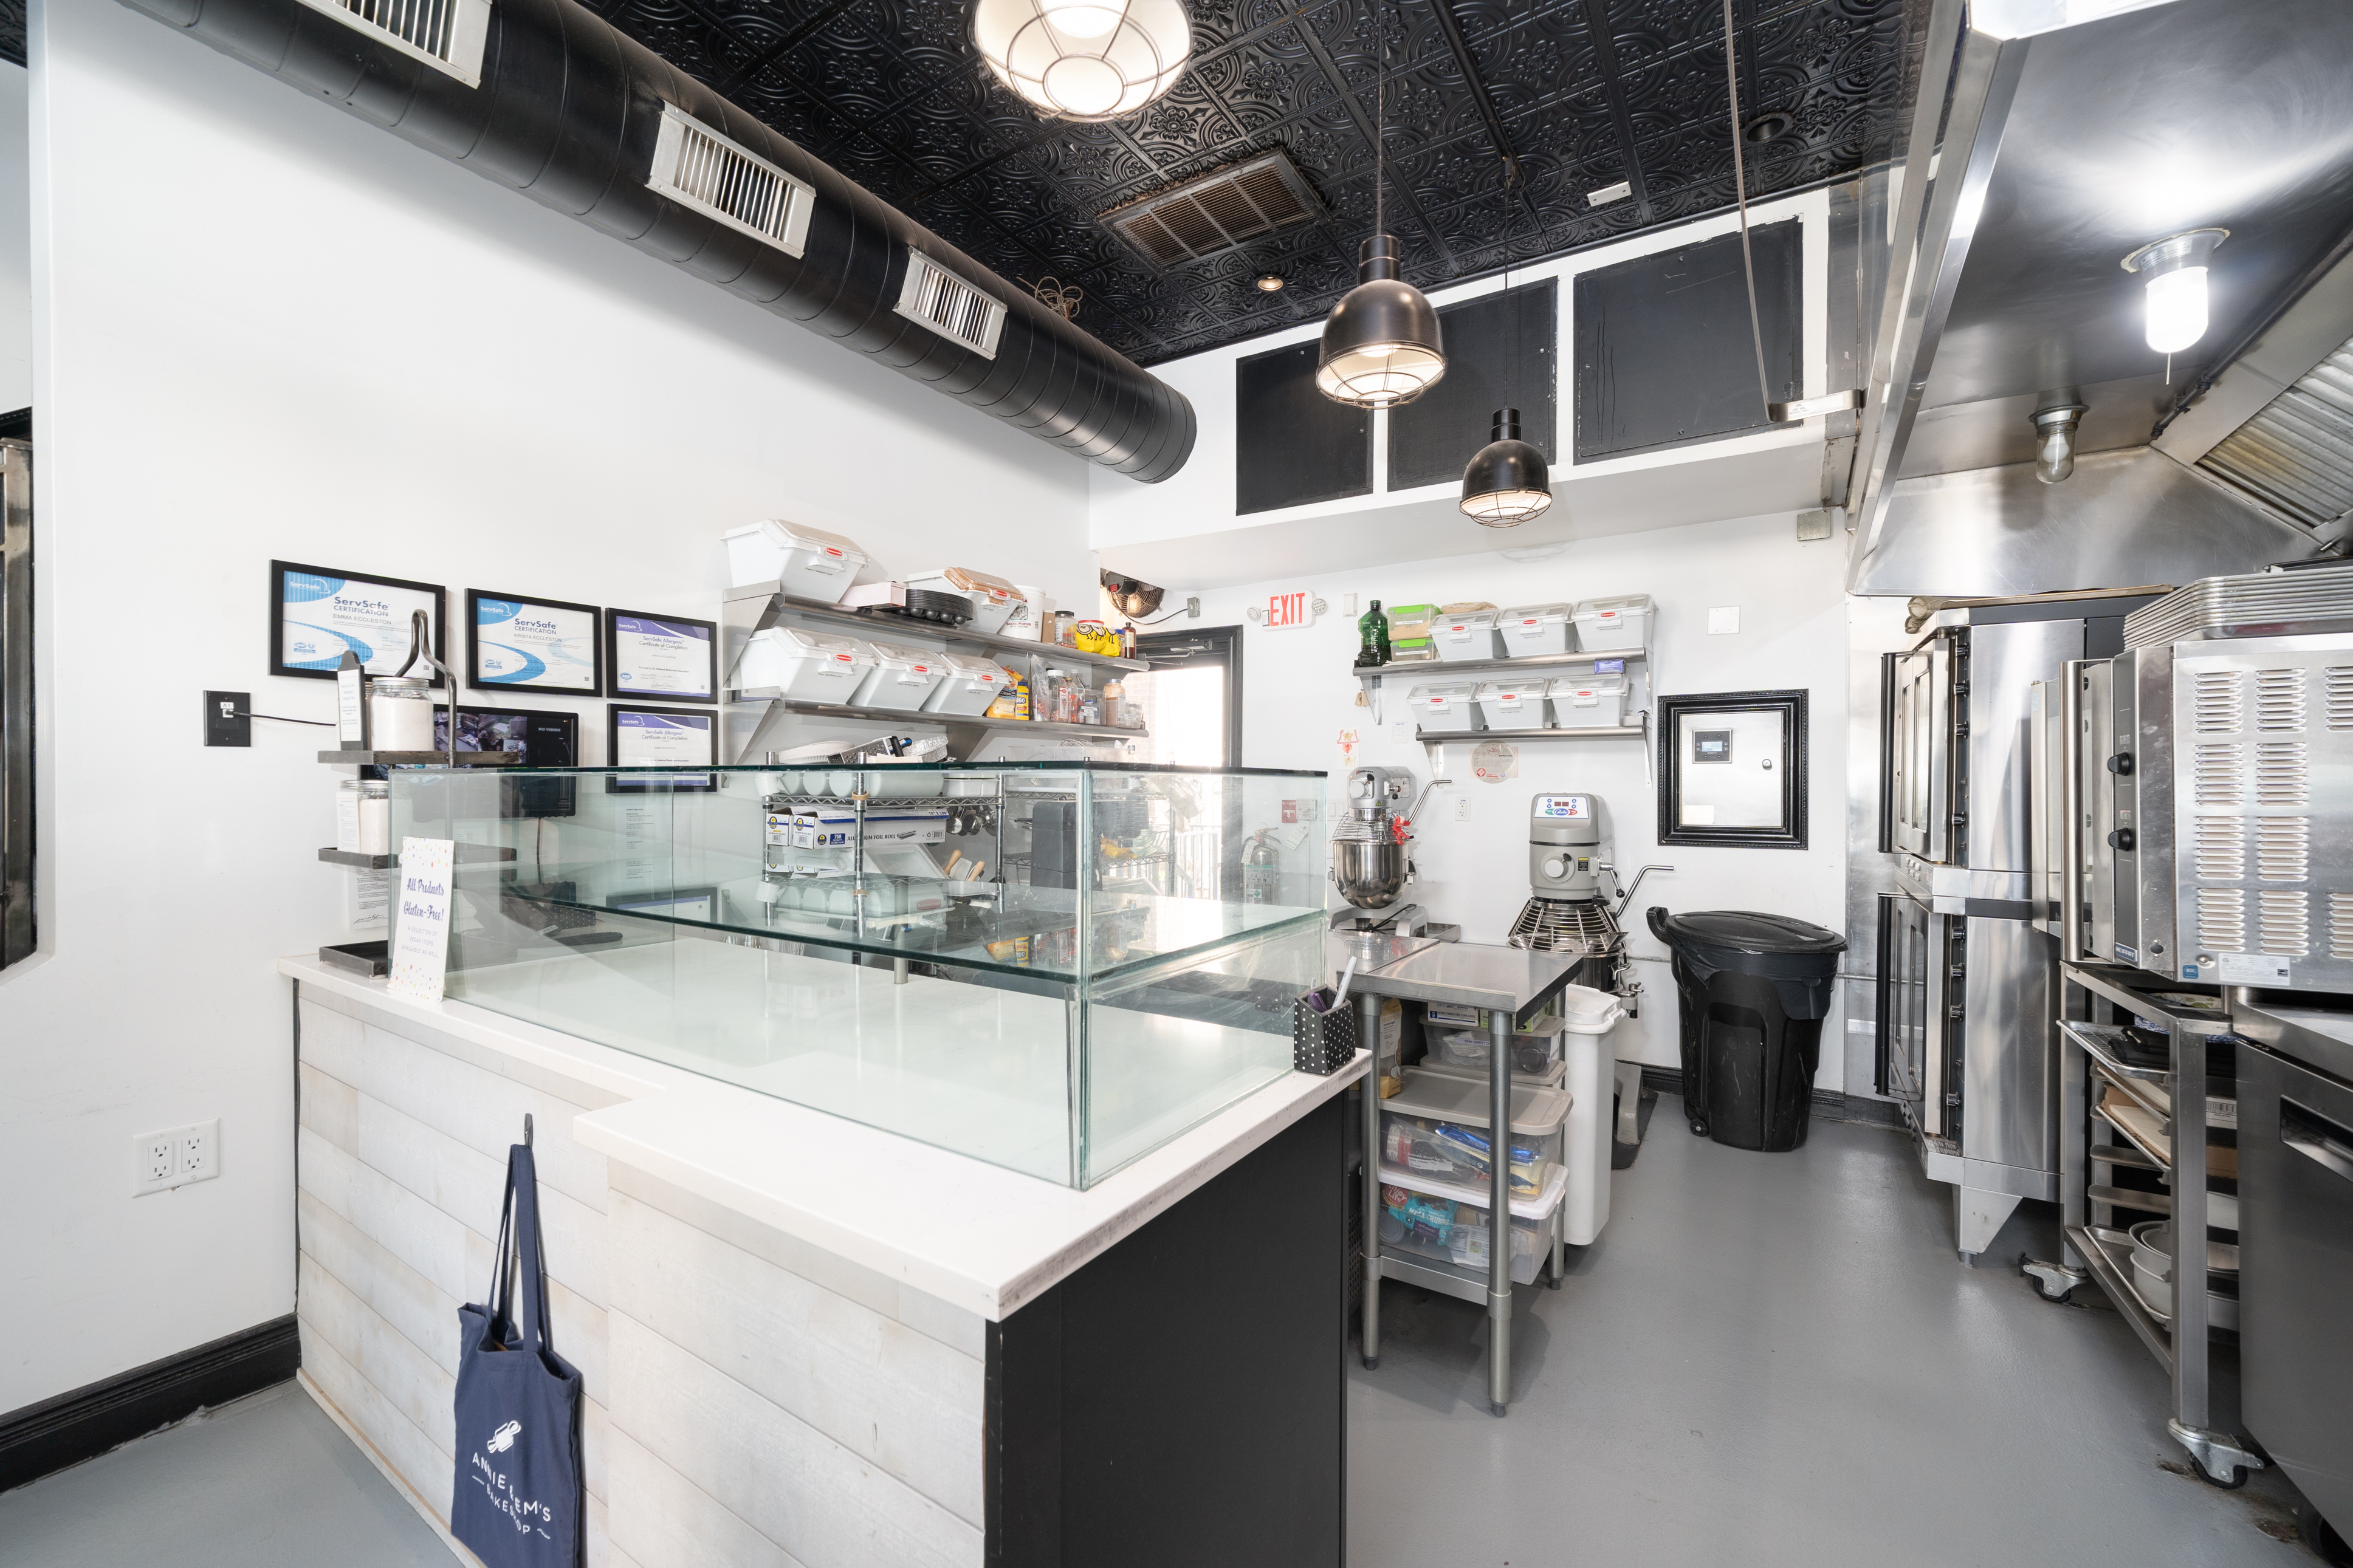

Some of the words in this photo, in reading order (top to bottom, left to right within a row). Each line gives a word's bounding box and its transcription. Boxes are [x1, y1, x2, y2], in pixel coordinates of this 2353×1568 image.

[289, 581, 320, 591] ServSafe
[334, 597, 388, 611] ServSafe
[1270, 592, 1305, 626] EXIT
[334, 605, 388, 617] CERTIFICATION
[354, 617, 391, 625] ECCLESTON
[515, 618, 556, 629] ServSafe
[514, 626, 557, 634] CERTIFICATION
[407, 877, 416, 892] All
[417, 879, 444, 896] Products
[404, 900, 444, 922] Gluten-Free!
[411, 926, 431, 936] SELECTION
[422, 938, 434, 947] ITEMS
[401, 944, 421, 954] AVAILABLE
[2115, 946, 2135, 957] MOFFAT
[1388, 1185, 1407, 1200] Enjoy
[1388, 1190, 1402, 1203] Life
[1409, 1208, 1425, 1219] MEGA
[1426, 1214, 1450, 1226] CHUNKS
[472, 1452, 506, 1489] ANNIE
[515, 1498, 551, 1522] EM'S
